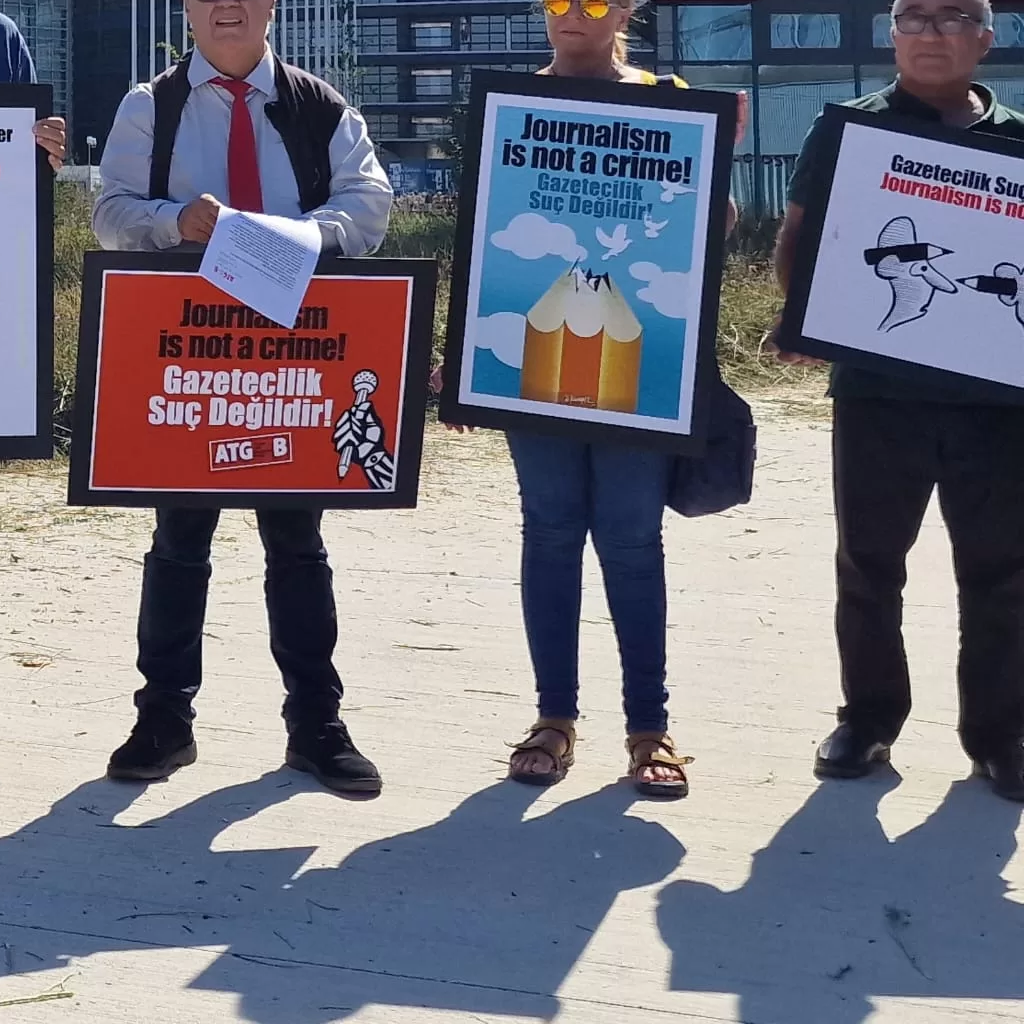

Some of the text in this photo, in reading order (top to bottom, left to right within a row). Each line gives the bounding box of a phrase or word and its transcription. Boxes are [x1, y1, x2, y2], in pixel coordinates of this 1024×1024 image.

[521, 113, 672, 154] Journalism
[502, 139, 693, 184] is not a crime!
[891, 154, 992, 192] Gazetecilik
[537, 172, 644, 201] Gazetecilik
[880, 172, 982, 210] Journalism
[983, 194, 1002, 215] is
[529, 190, 653, 220] Suç Değildir!
[158, 329, 347, 362] is not a crime!
[163, 364, 323, 397] Gazetecilik
[148, 395, 335, 431] Suç Değildir!
[214, 441, 254, 464] ATG
[272, 437, 288, 457] B
